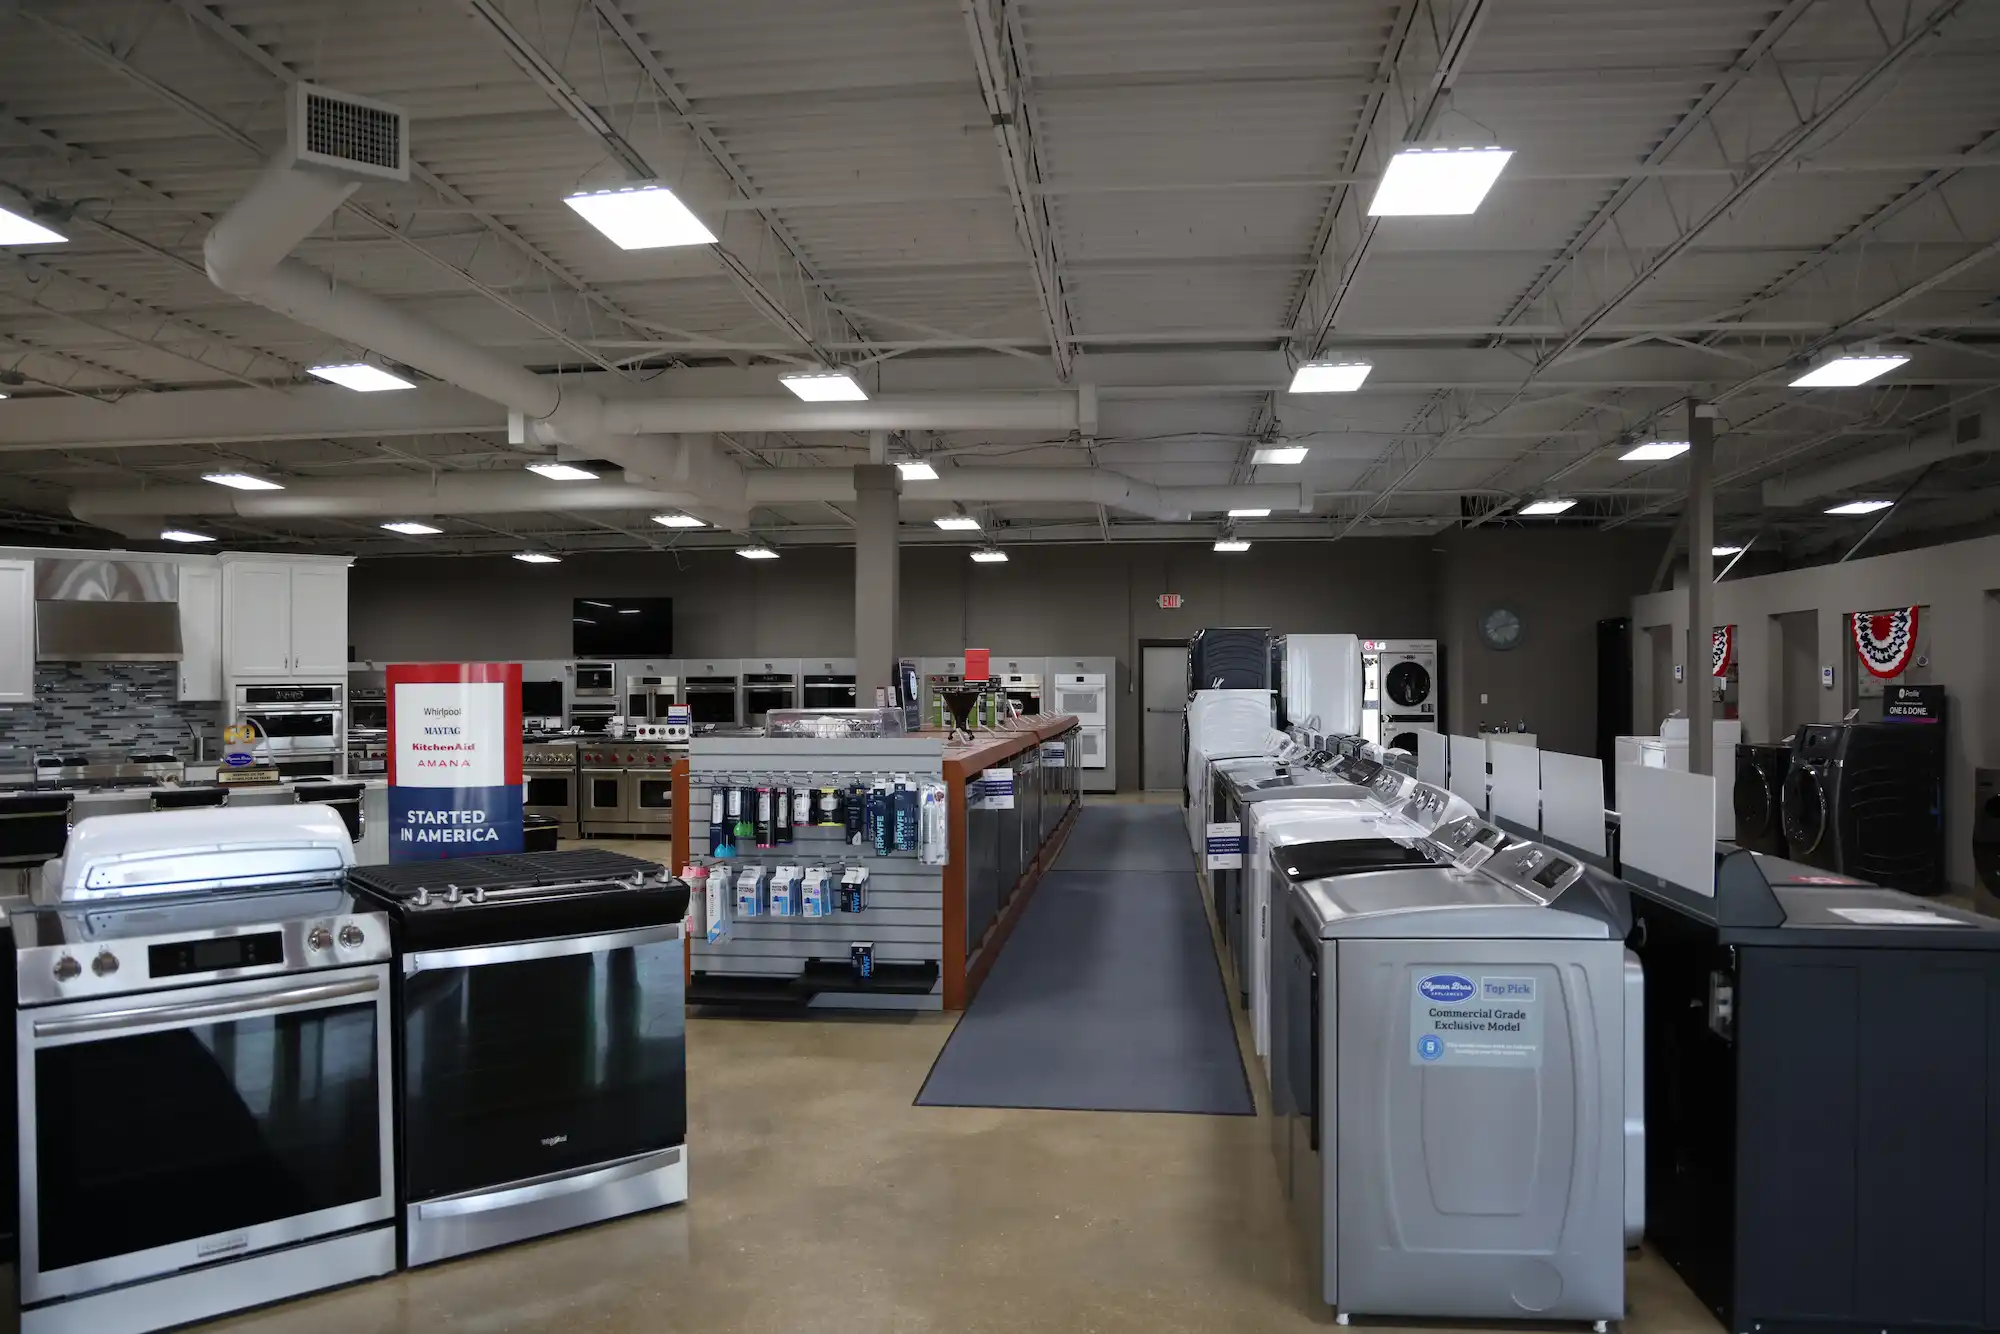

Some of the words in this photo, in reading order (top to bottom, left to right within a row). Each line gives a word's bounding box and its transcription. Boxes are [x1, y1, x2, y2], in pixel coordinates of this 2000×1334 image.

[1162, 595, 1178, 607] EXIT
[424, 707, 462, 718] Whirlpool
[1889, 706, 1902, 714] ONE
[1902, 707, 1907, 715] &
[1907, 707, 1928, 715] DONE.
[424, 726, 461, 735] MAYTAG
[412, 743, 475, 751] KitchenAid
[418, 759, 470, 768] AMANA
[407, 810, 486, 825] STARTED
[401, 828, 413, 842] IN
[417, 828, 499, 843] AMERICA
[1422, 981, 1450, 992] Slyman
[1451, 981, 1472, 991] Bros
[1484, 984, 1505, 995] Top
[1507, 984, 1530, 994] Pick
[1428, 1007, 1492, 1019] Commercial
[1494, 1009, 1526, 1020] Grade
[1434, 1020, 1485, 1031] Exclusive
[1487, 1021, 1520, 1032] Model
